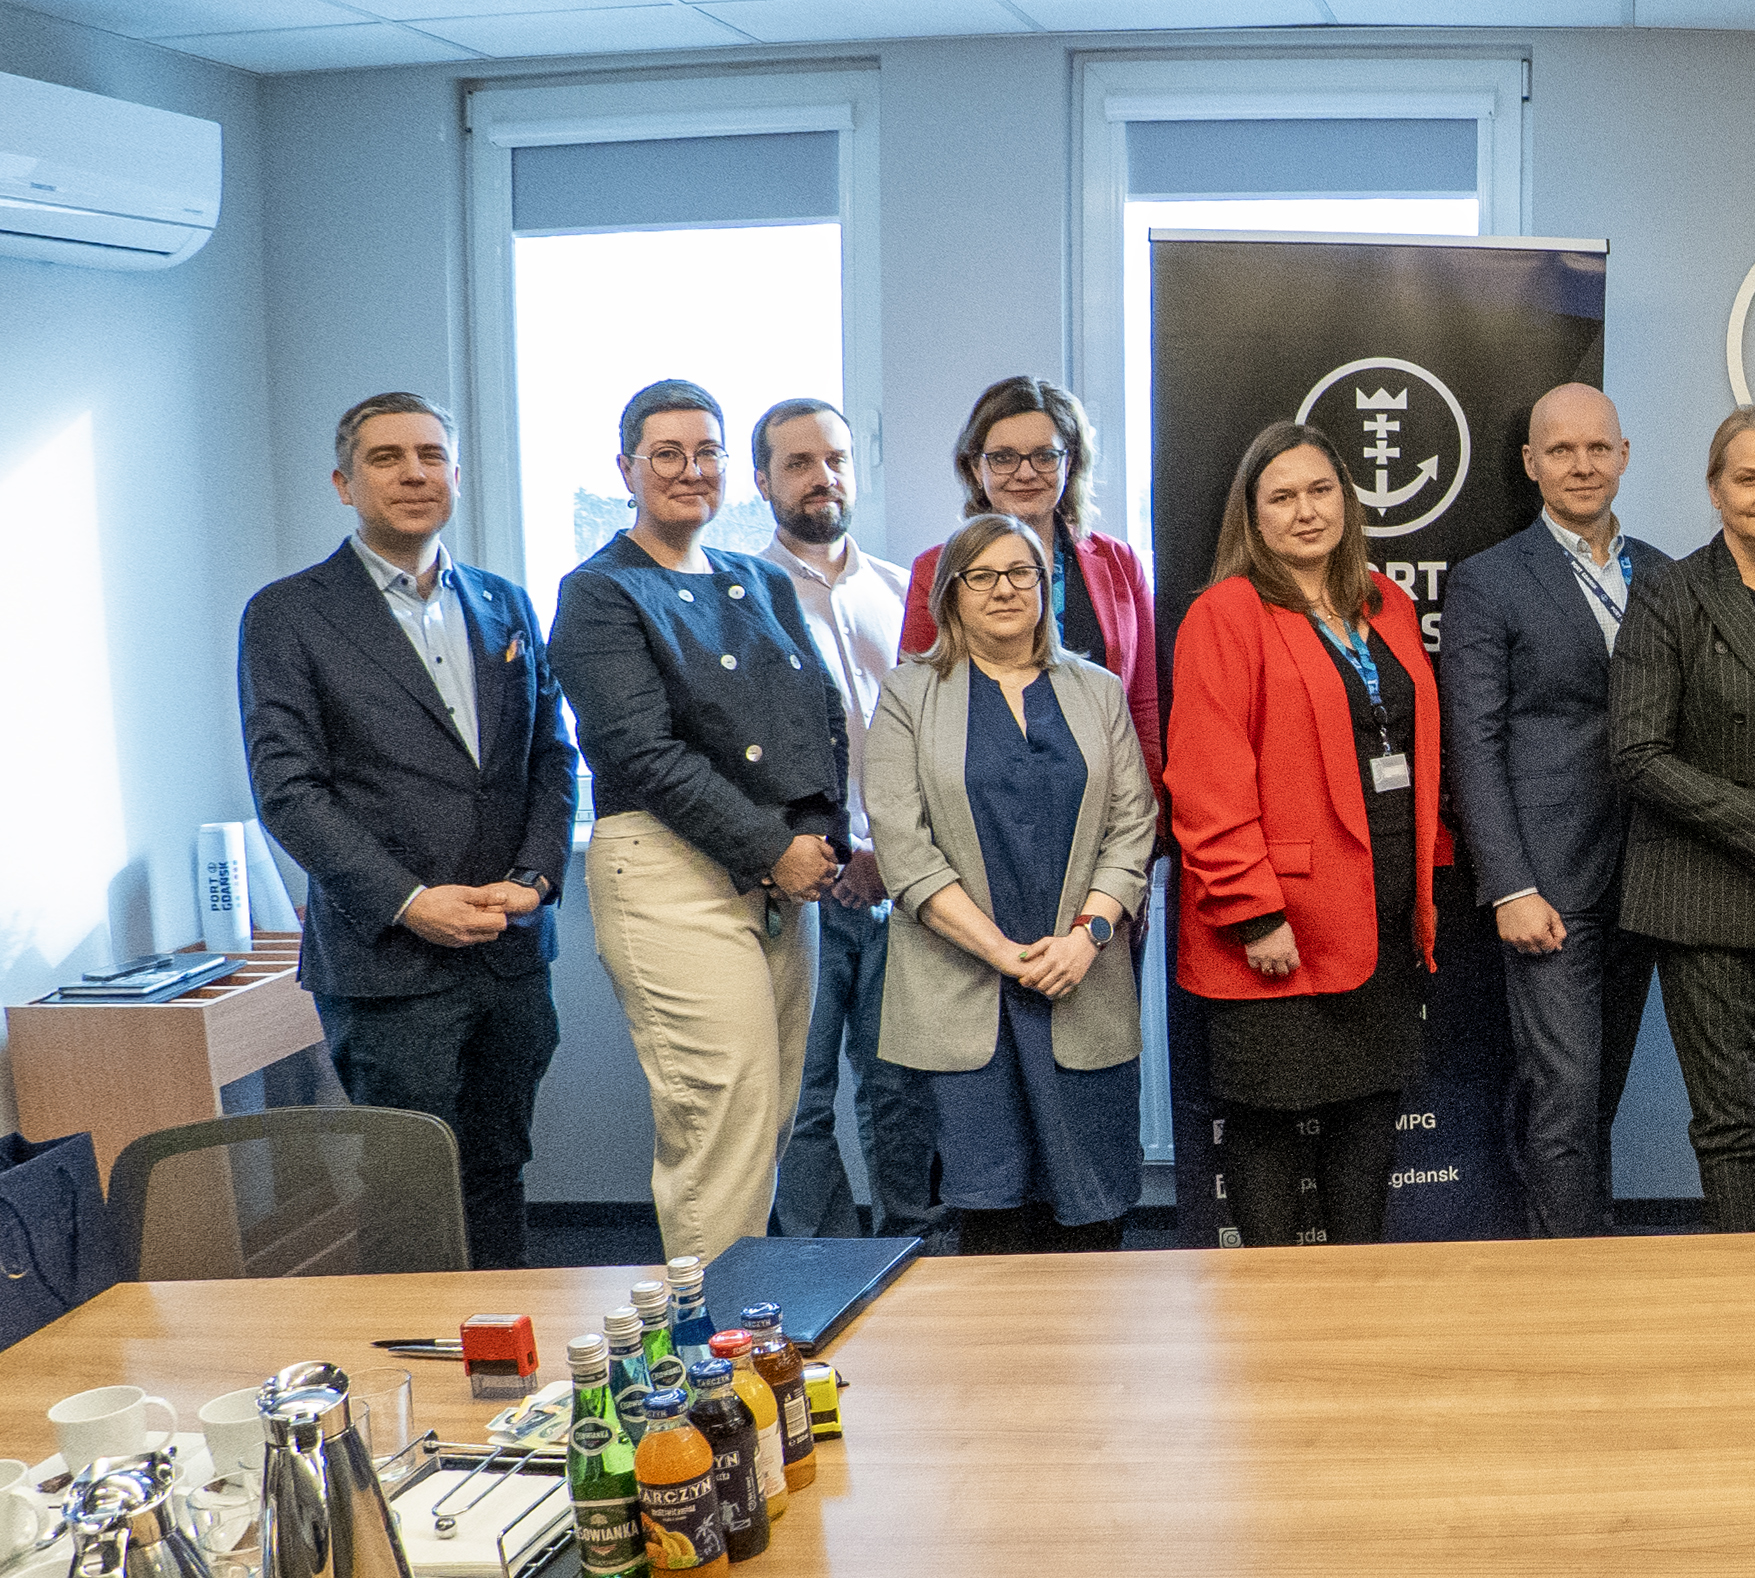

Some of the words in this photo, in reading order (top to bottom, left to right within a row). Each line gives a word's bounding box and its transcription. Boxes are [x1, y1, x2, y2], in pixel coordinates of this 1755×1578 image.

[1366, 561, 1447, 601] RT
[208, 877, 221, 912] PORT
[219, 861, 233, 911] GDAŃSK
